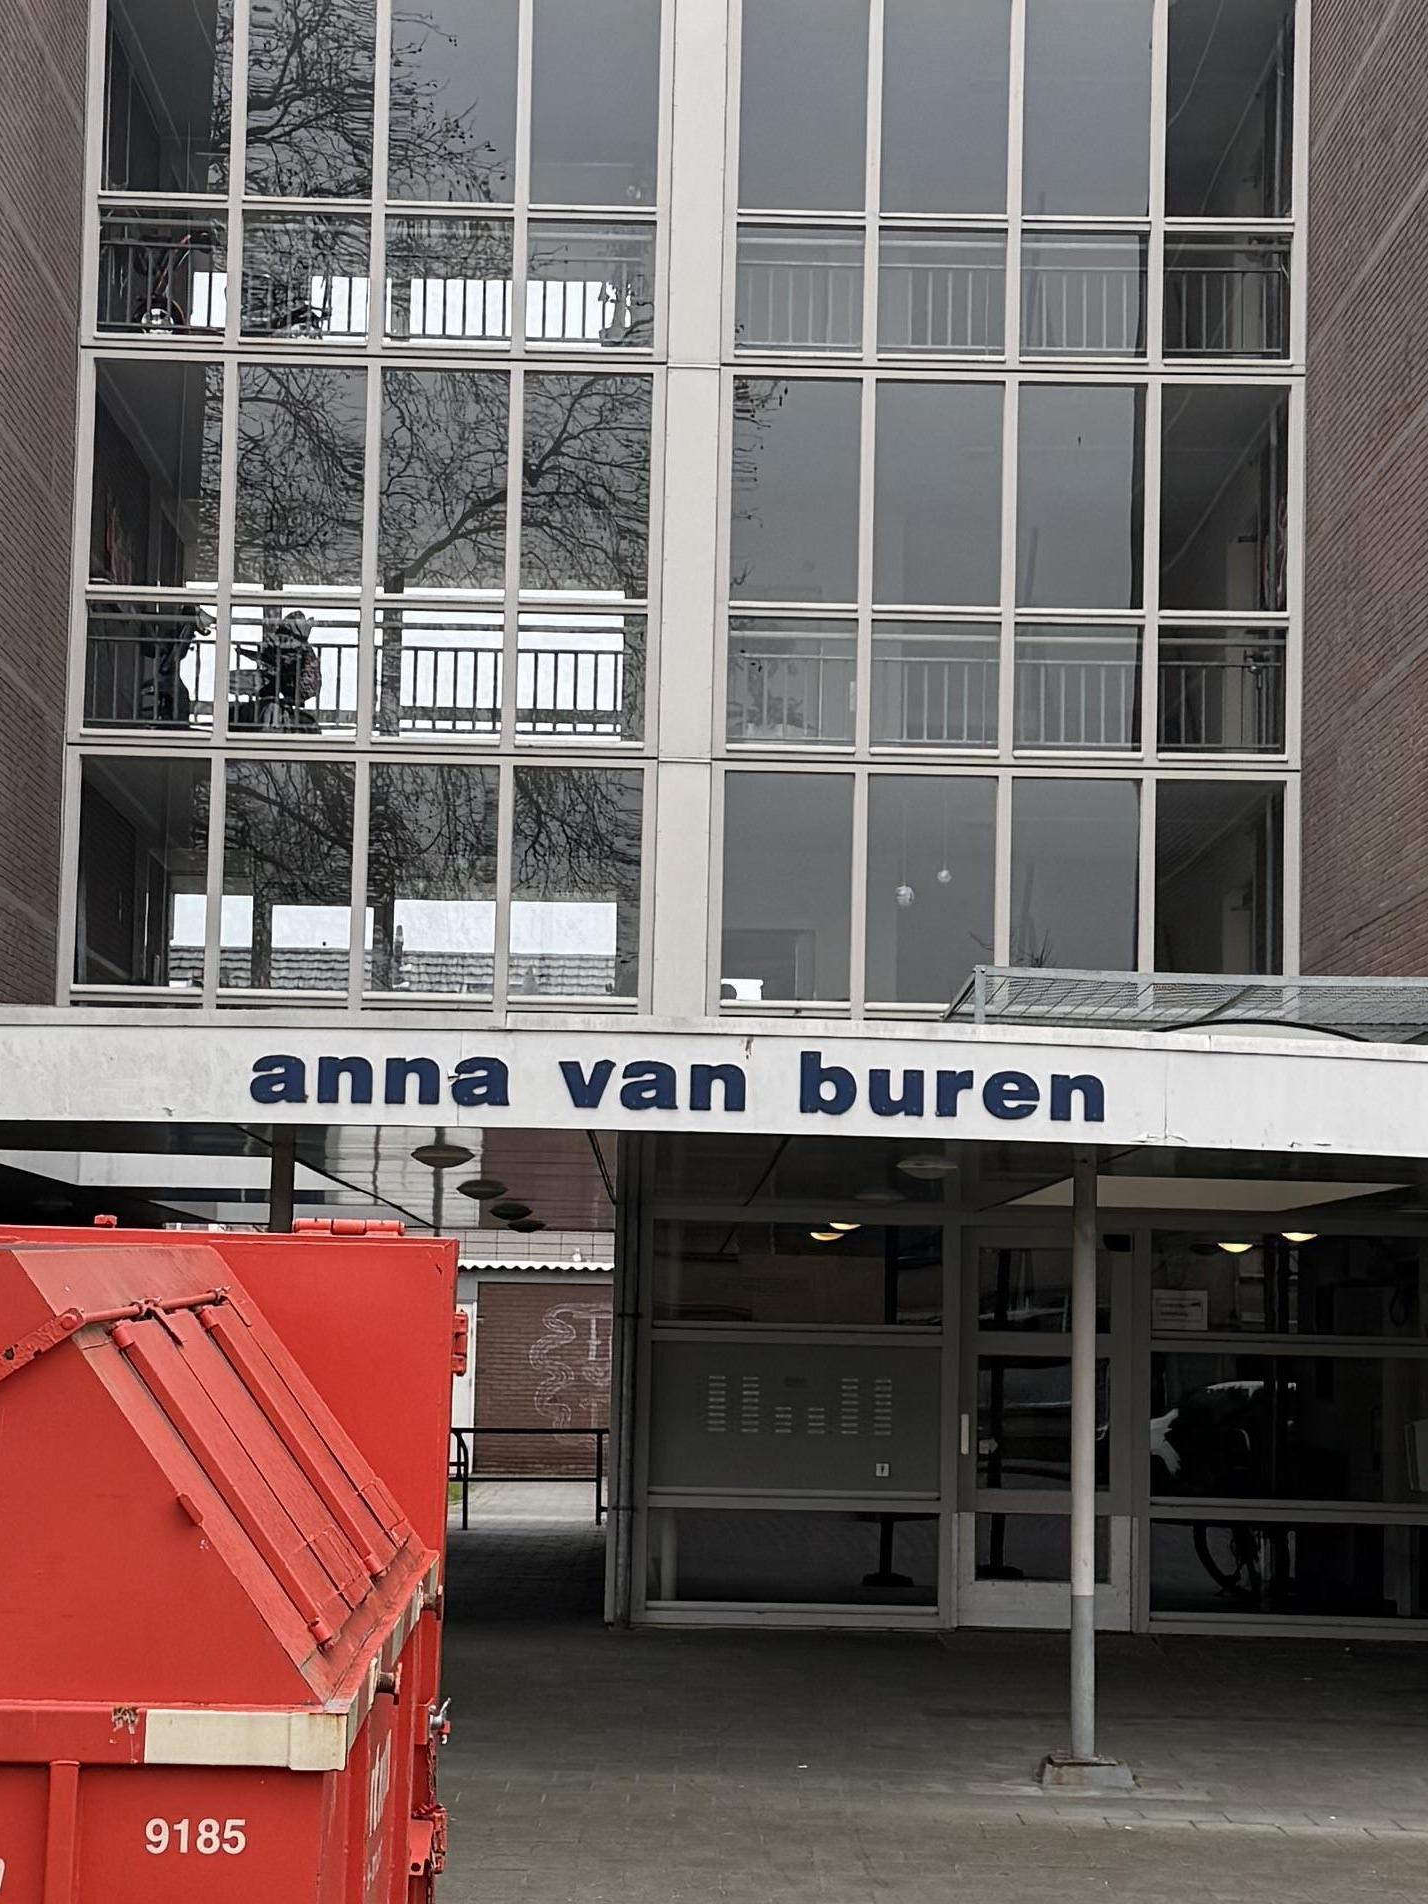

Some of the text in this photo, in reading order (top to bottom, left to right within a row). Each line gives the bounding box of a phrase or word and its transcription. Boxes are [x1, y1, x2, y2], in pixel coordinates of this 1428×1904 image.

[250, 1051, 1107, 1123] anna van buren
[145, 1818, 247, 1855] 9185
